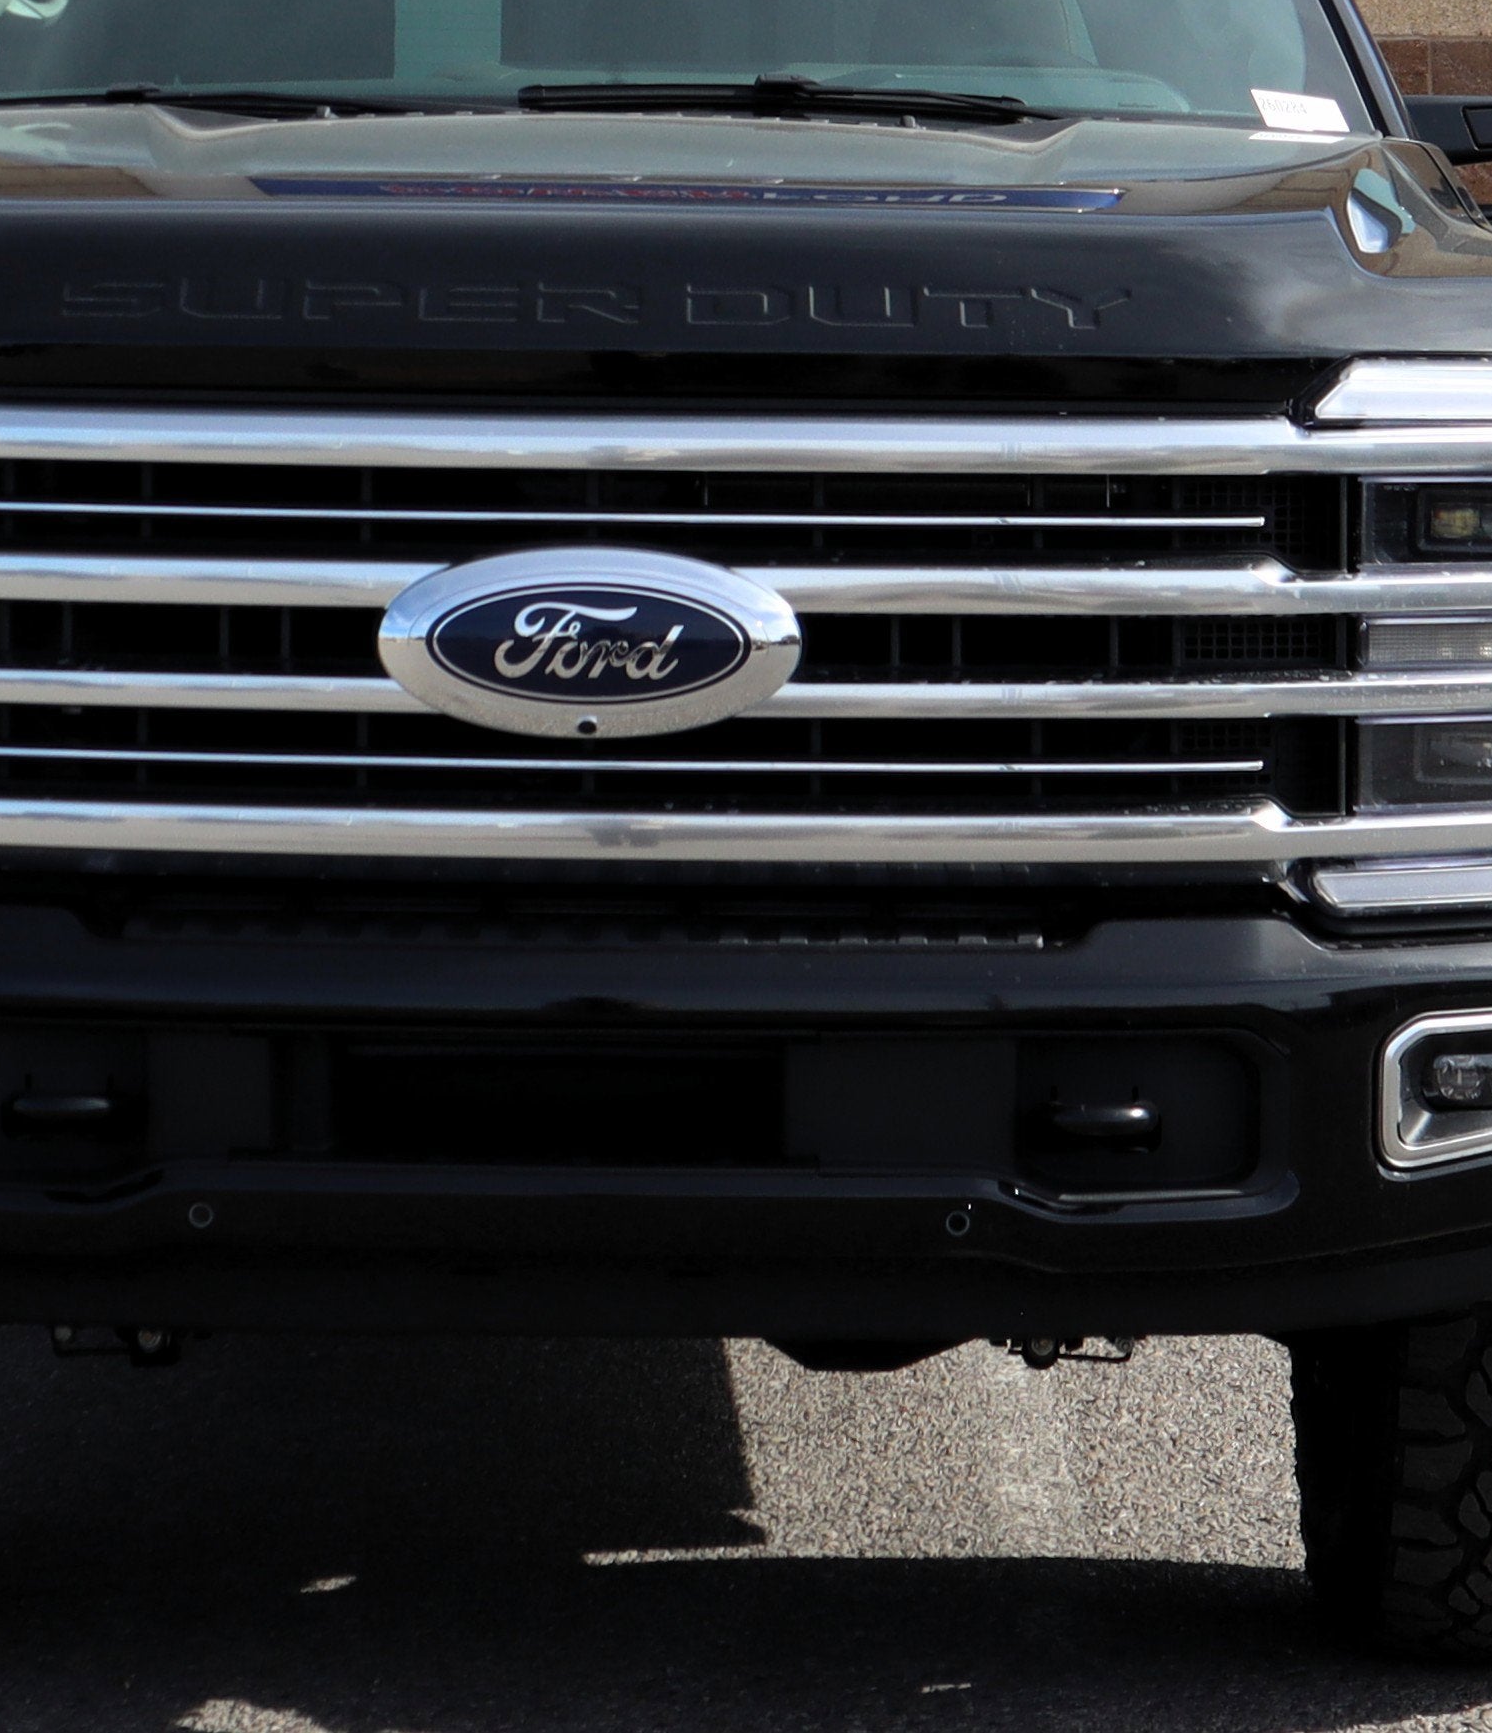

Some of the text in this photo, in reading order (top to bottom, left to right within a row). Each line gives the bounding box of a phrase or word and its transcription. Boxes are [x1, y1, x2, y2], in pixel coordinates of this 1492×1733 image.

[62, 277, 1130, 331] SUPER DUTY
[494, 601, 685, 681] Ford
